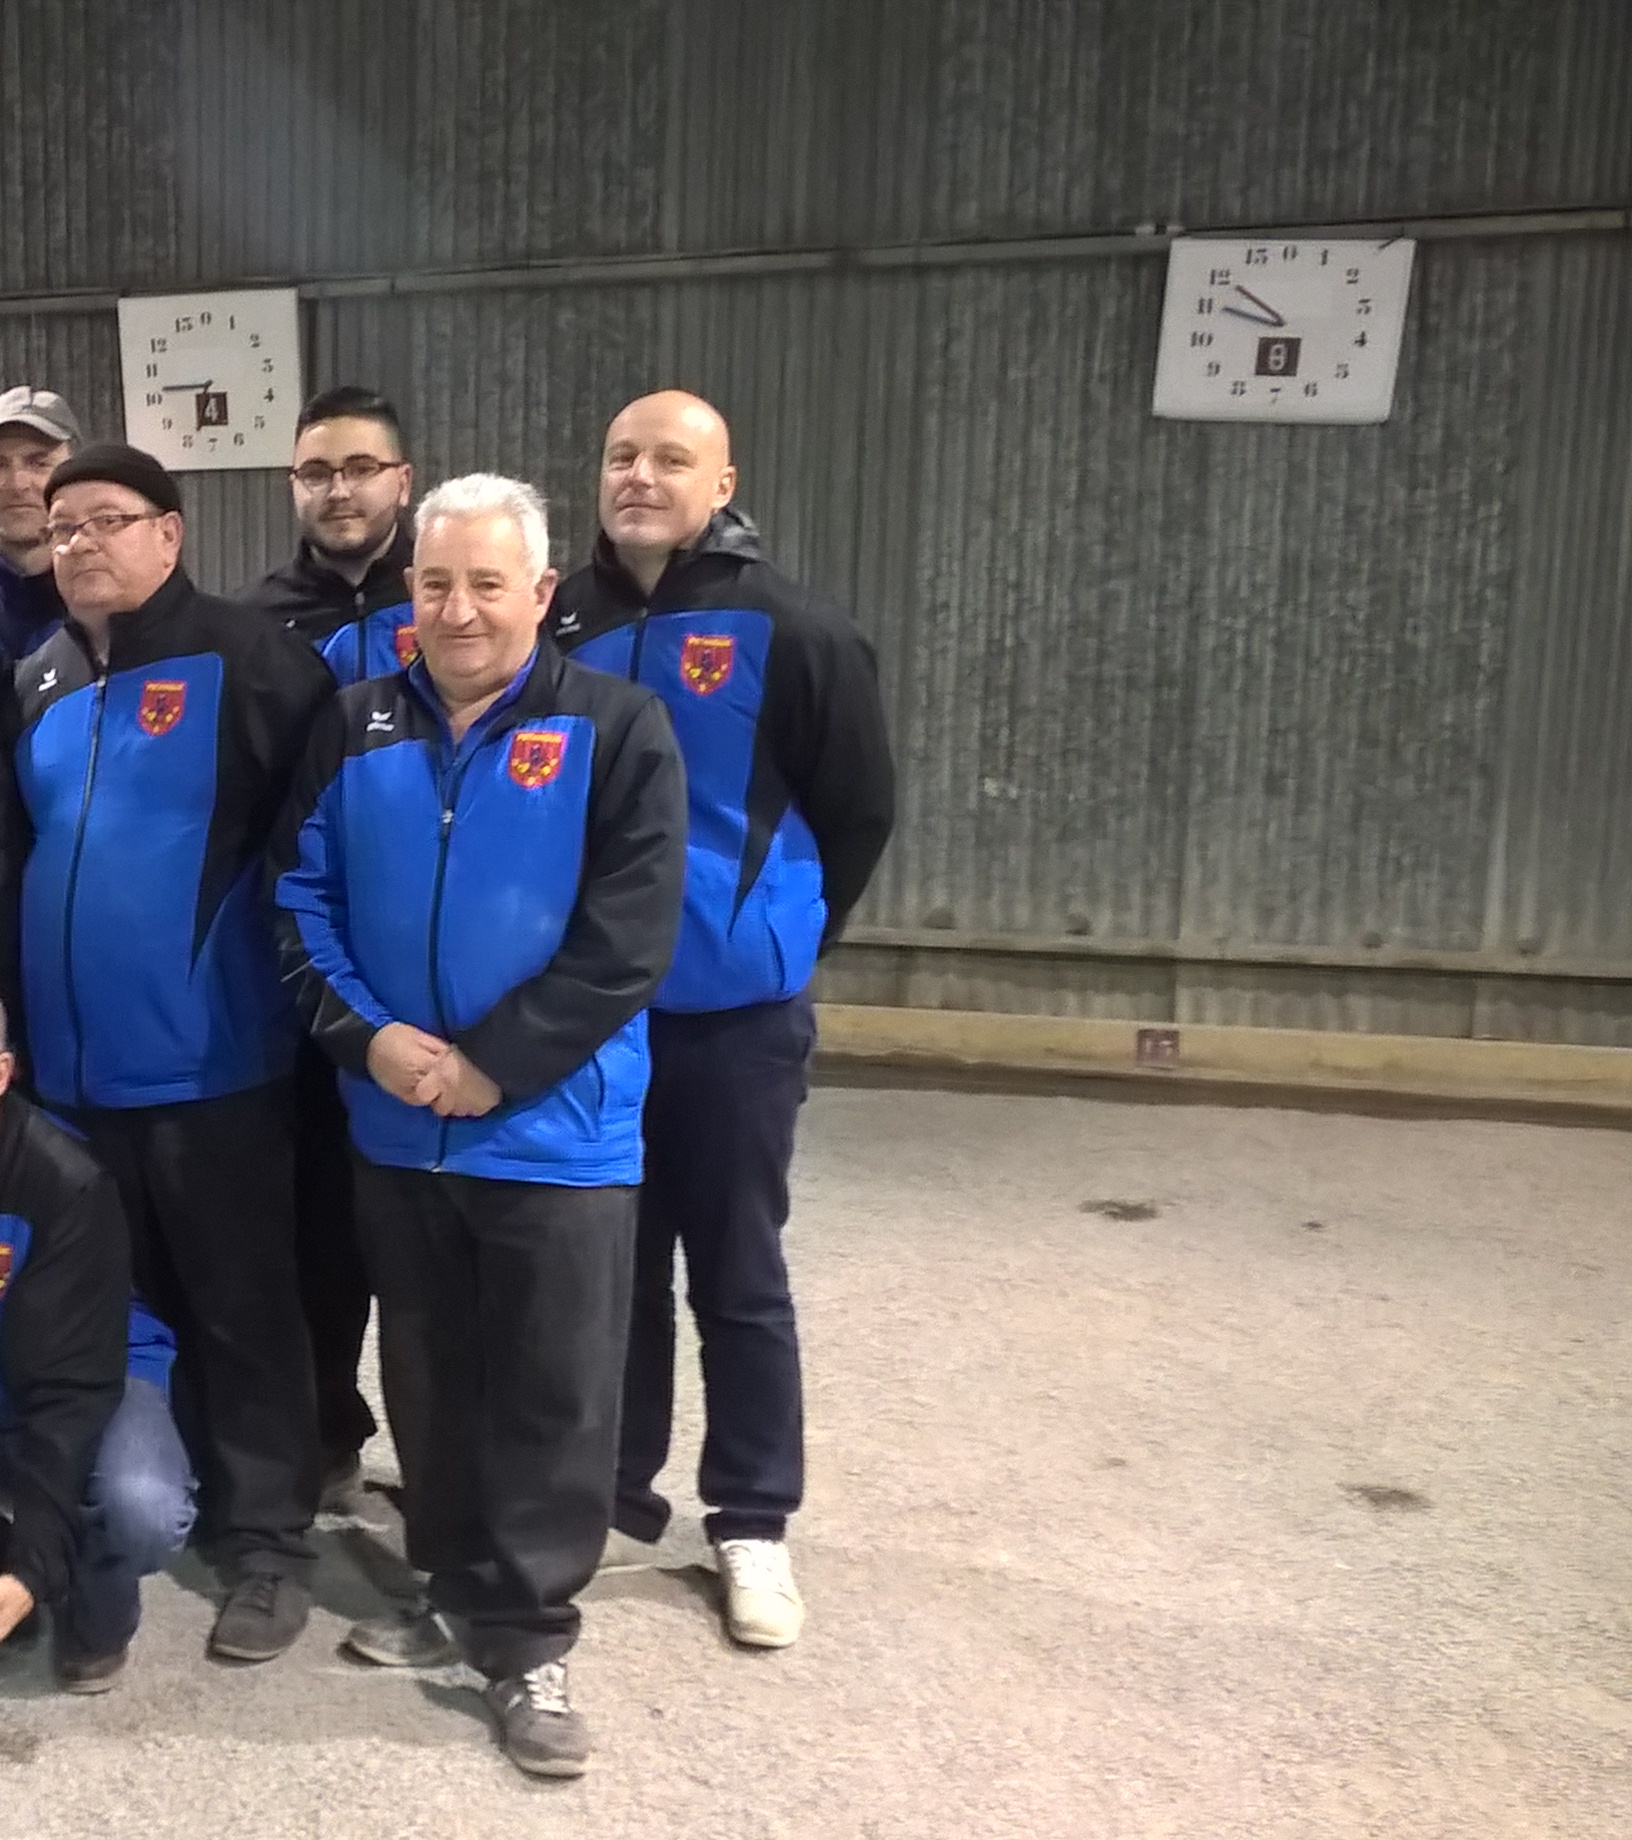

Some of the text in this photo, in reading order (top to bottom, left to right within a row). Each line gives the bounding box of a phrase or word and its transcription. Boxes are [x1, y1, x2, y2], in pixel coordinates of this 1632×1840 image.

[1282, 246, 1298, 262] 0
[1320, 249, 1328, 266] 1
[1210, 268, 1230, 285] 12
[1345, 268, 1359, 284] 2
[1198, 297, 1213, 314] 11
[200, 311, 211, 326] 0
[229, 315, 235, 330] 1
[150, 338, 167, 353] 12
[250, 333, 260, 348] 2
[1191, 331, 1213, 347] 10
[1353, 331, 1367, 347] 4
[146, 363, 157, 378] 11
[264, 387, 274, 402] 4
[1270, 387, 1281, 403] 7
[204, 398, 218, 421] 4
[182, 434, 193, 448] 8
[208, 437, 218, 452] 7
[234, 432, 245, 446] 6
